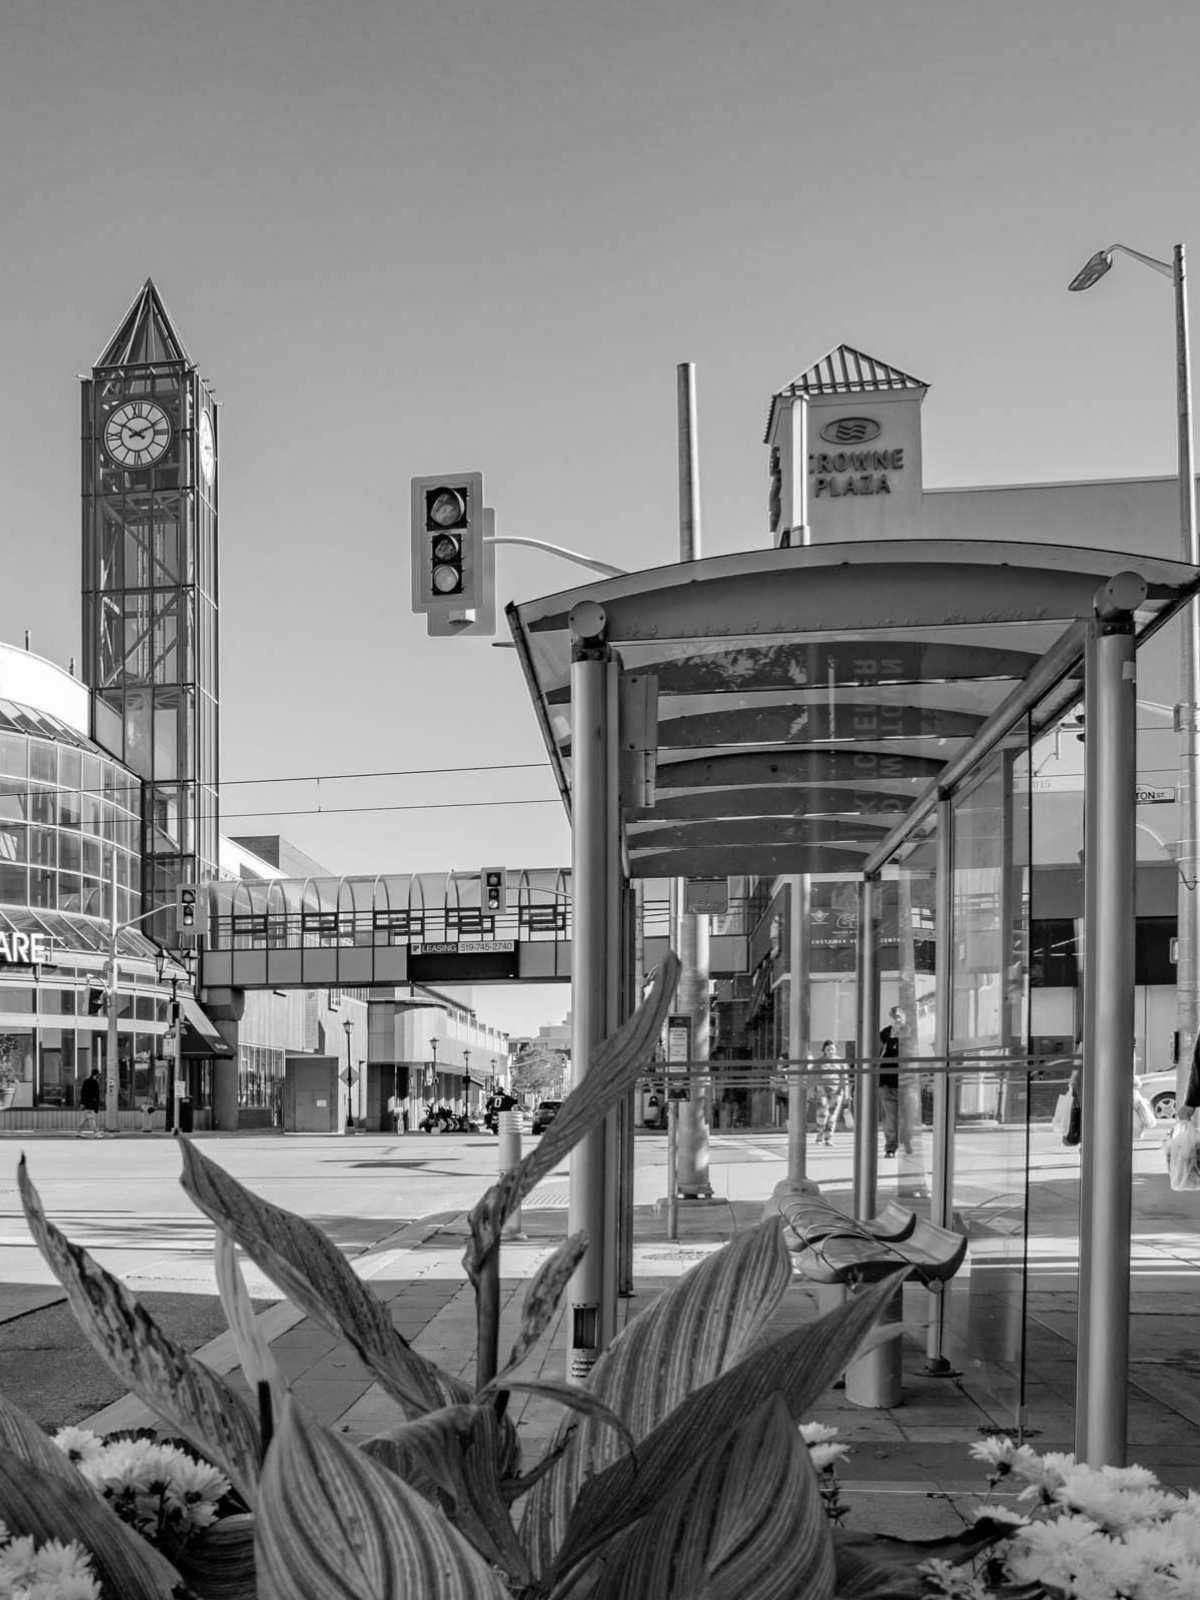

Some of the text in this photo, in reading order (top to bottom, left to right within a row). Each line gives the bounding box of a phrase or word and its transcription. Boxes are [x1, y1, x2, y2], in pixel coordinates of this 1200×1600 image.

[815, 473, 891, 498] PLAZA
[422, 941, 513, 953] LEASING 519-745-2740
[494, 1097, 502, 1108] 0
